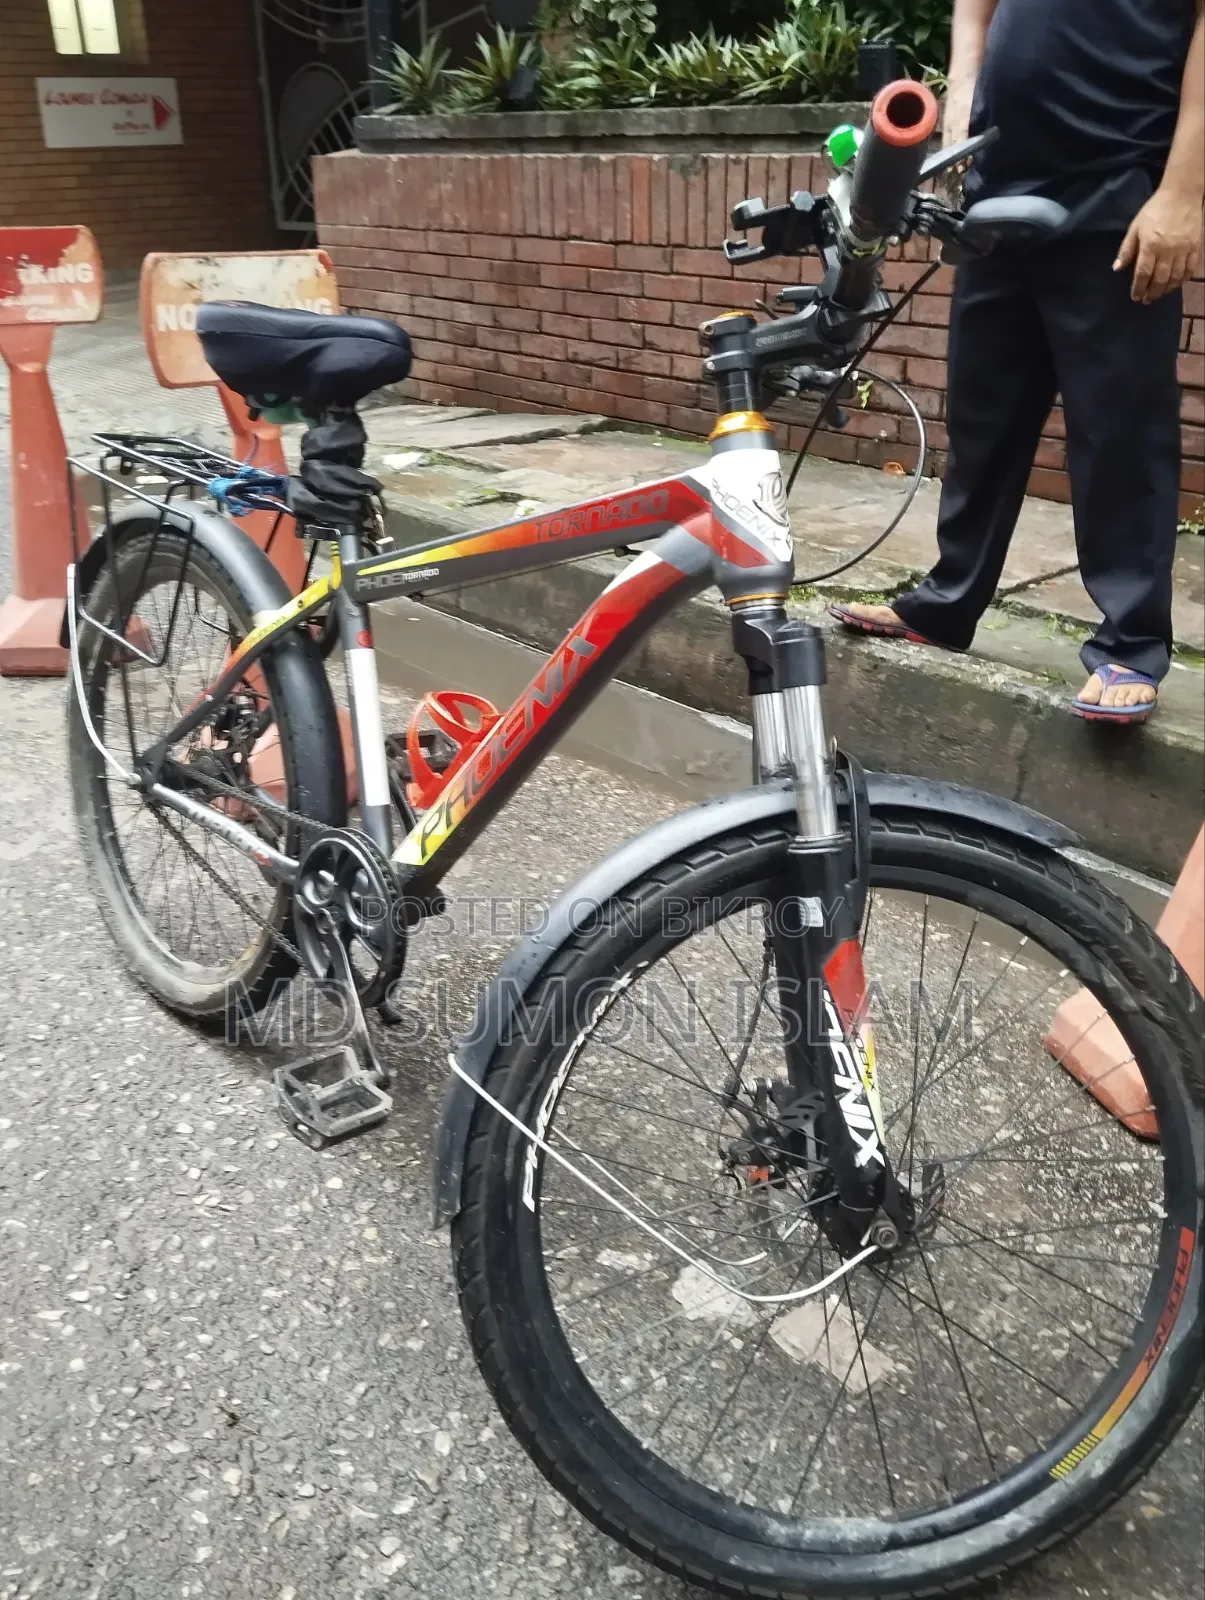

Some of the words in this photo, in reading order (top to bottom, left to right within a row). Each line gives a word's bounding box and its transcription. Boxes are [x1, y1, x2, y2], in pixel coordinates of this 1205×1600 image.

[156, 303, 197, 332] NO
[534, 488, 669, 541] TORNADO
[402, 568, 440, 581] TORNADO
[419, 618, 601, 862] PHOENIX
[1144, 1249, 1189, 1371] PHONIX
